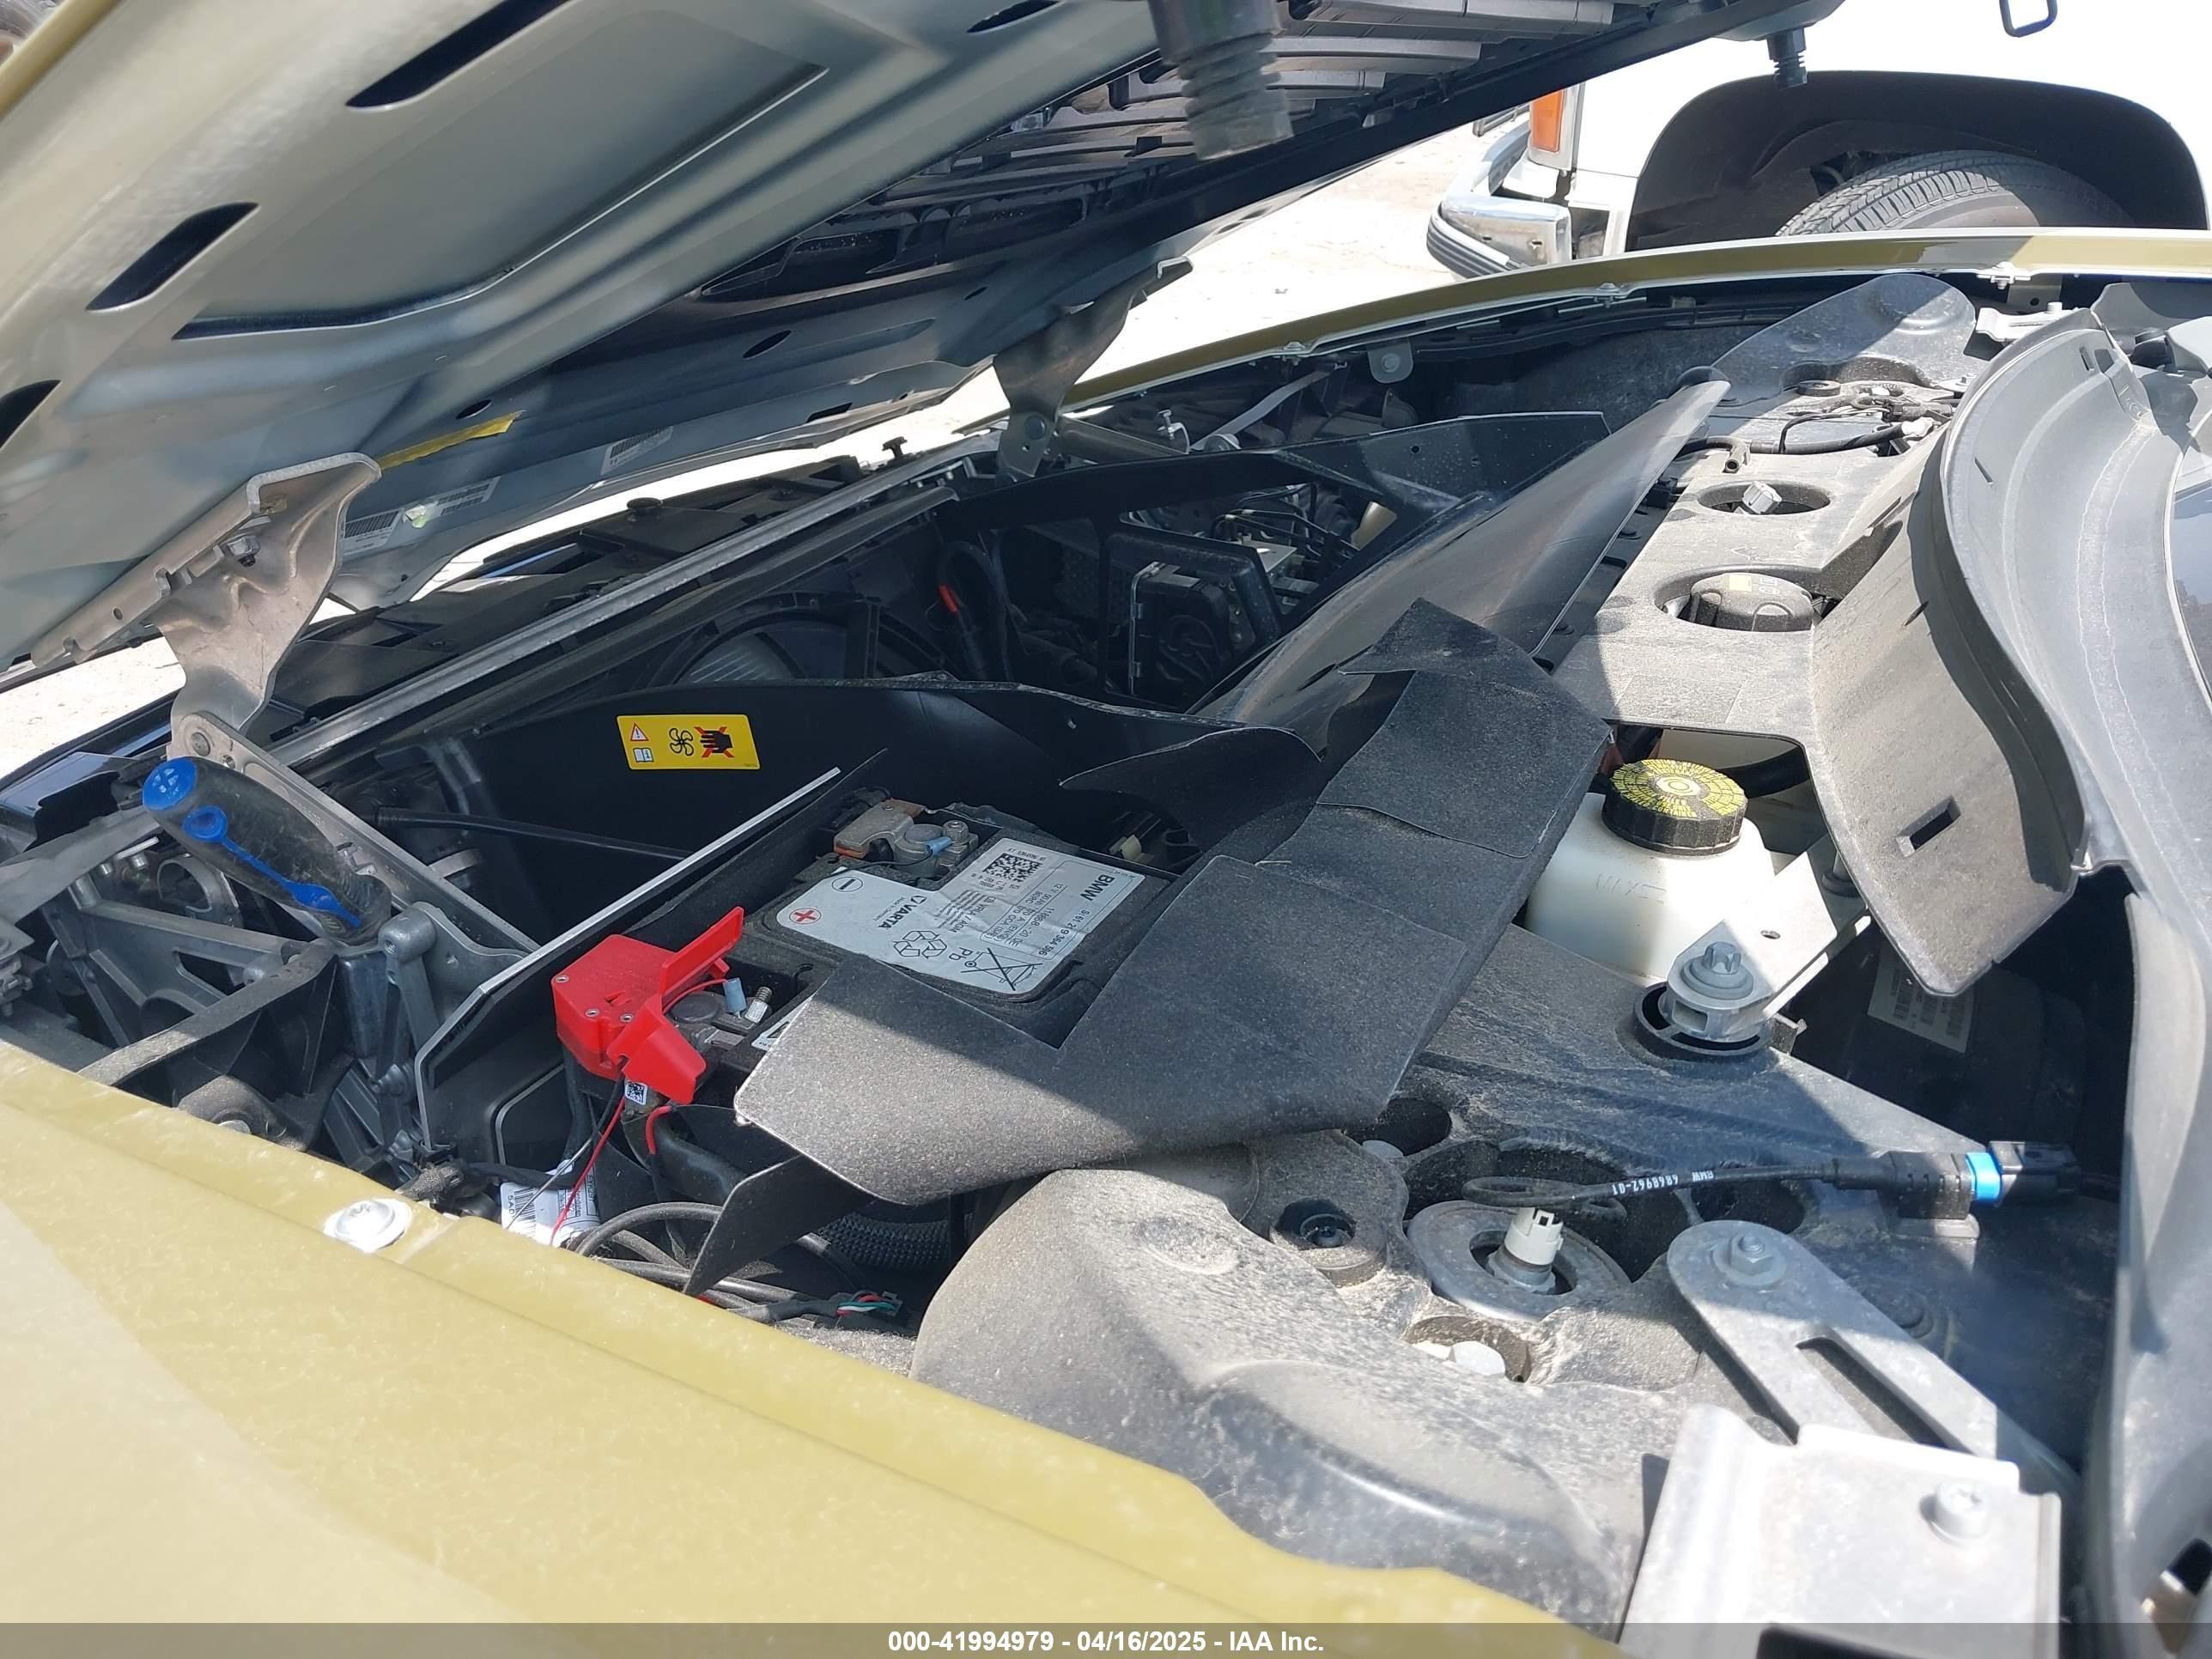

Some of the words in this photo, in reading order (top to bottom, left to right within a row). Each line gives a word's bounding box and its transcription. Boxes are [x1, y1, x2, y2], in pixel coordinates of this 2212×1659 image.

[1080, 874, 1115, 902] BMW
[877, 903, 917, 928] VARTA
[949, 946, 974, 961] Pb
[1611, 1173, 1679, 1196] 6868962-01
[1692, 1170, 1715, 1182] BMW
